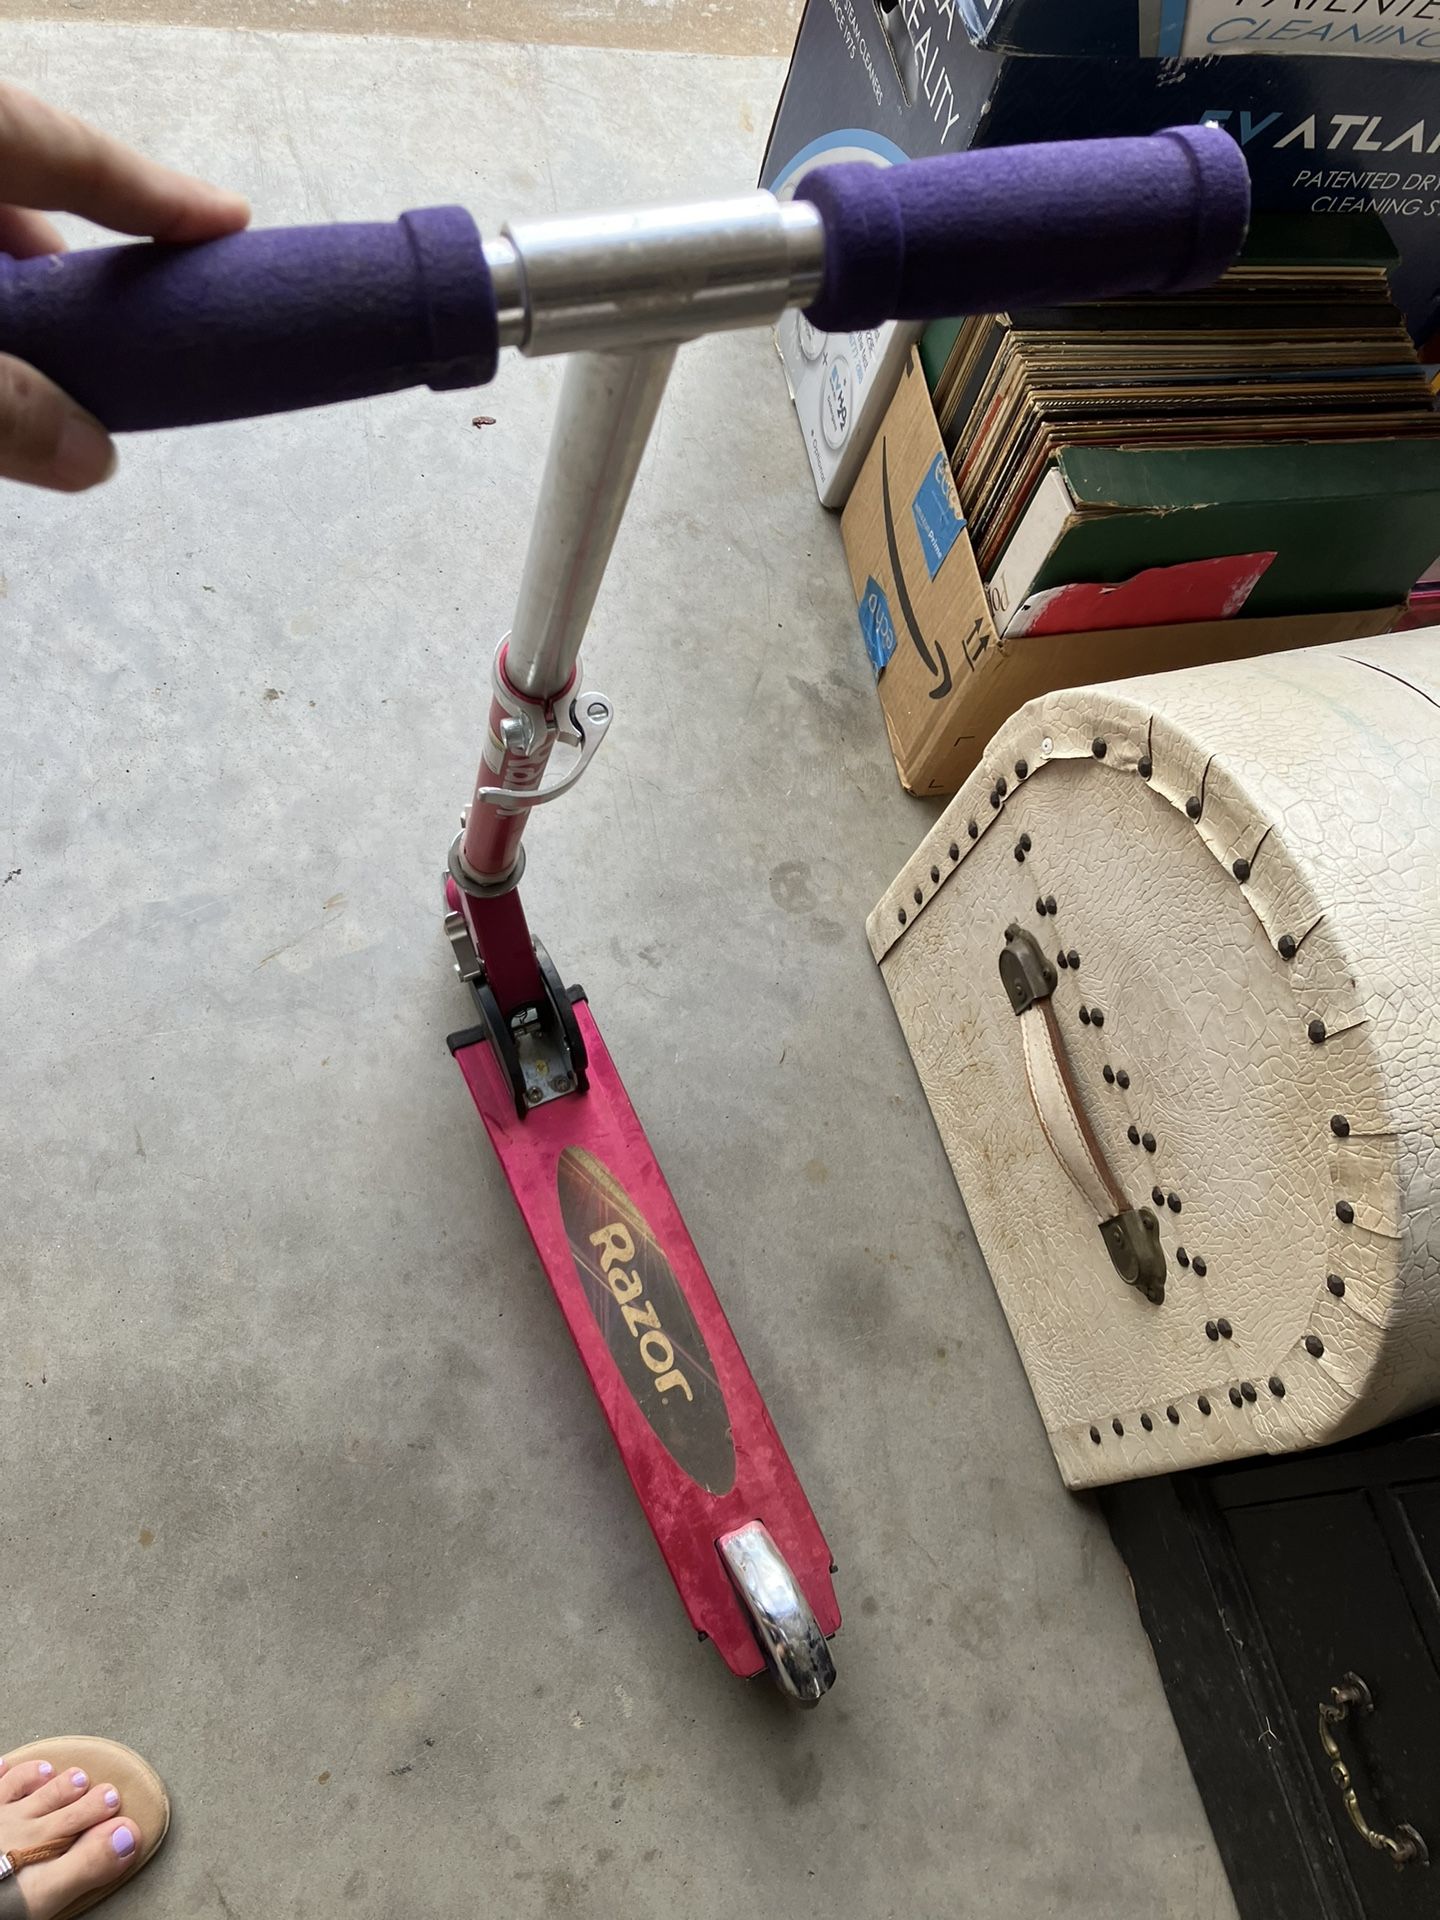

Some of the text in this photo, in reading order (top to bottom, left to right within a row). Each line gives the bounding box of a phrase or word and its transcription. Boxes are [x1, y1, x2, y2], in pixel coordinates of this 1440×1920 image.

[843, 25, 856, 59] 1975
[860, 38, 883, 106] CLEANERS
[902, 0, 959, 144] EALITY
[1273, 114, 1440, 154] ATLA
[1292, 170, 1401, 191] PATENTED
[1310, 196, 1423, 216] CLEANING
[588, 1221, 694, 1403] Razor
